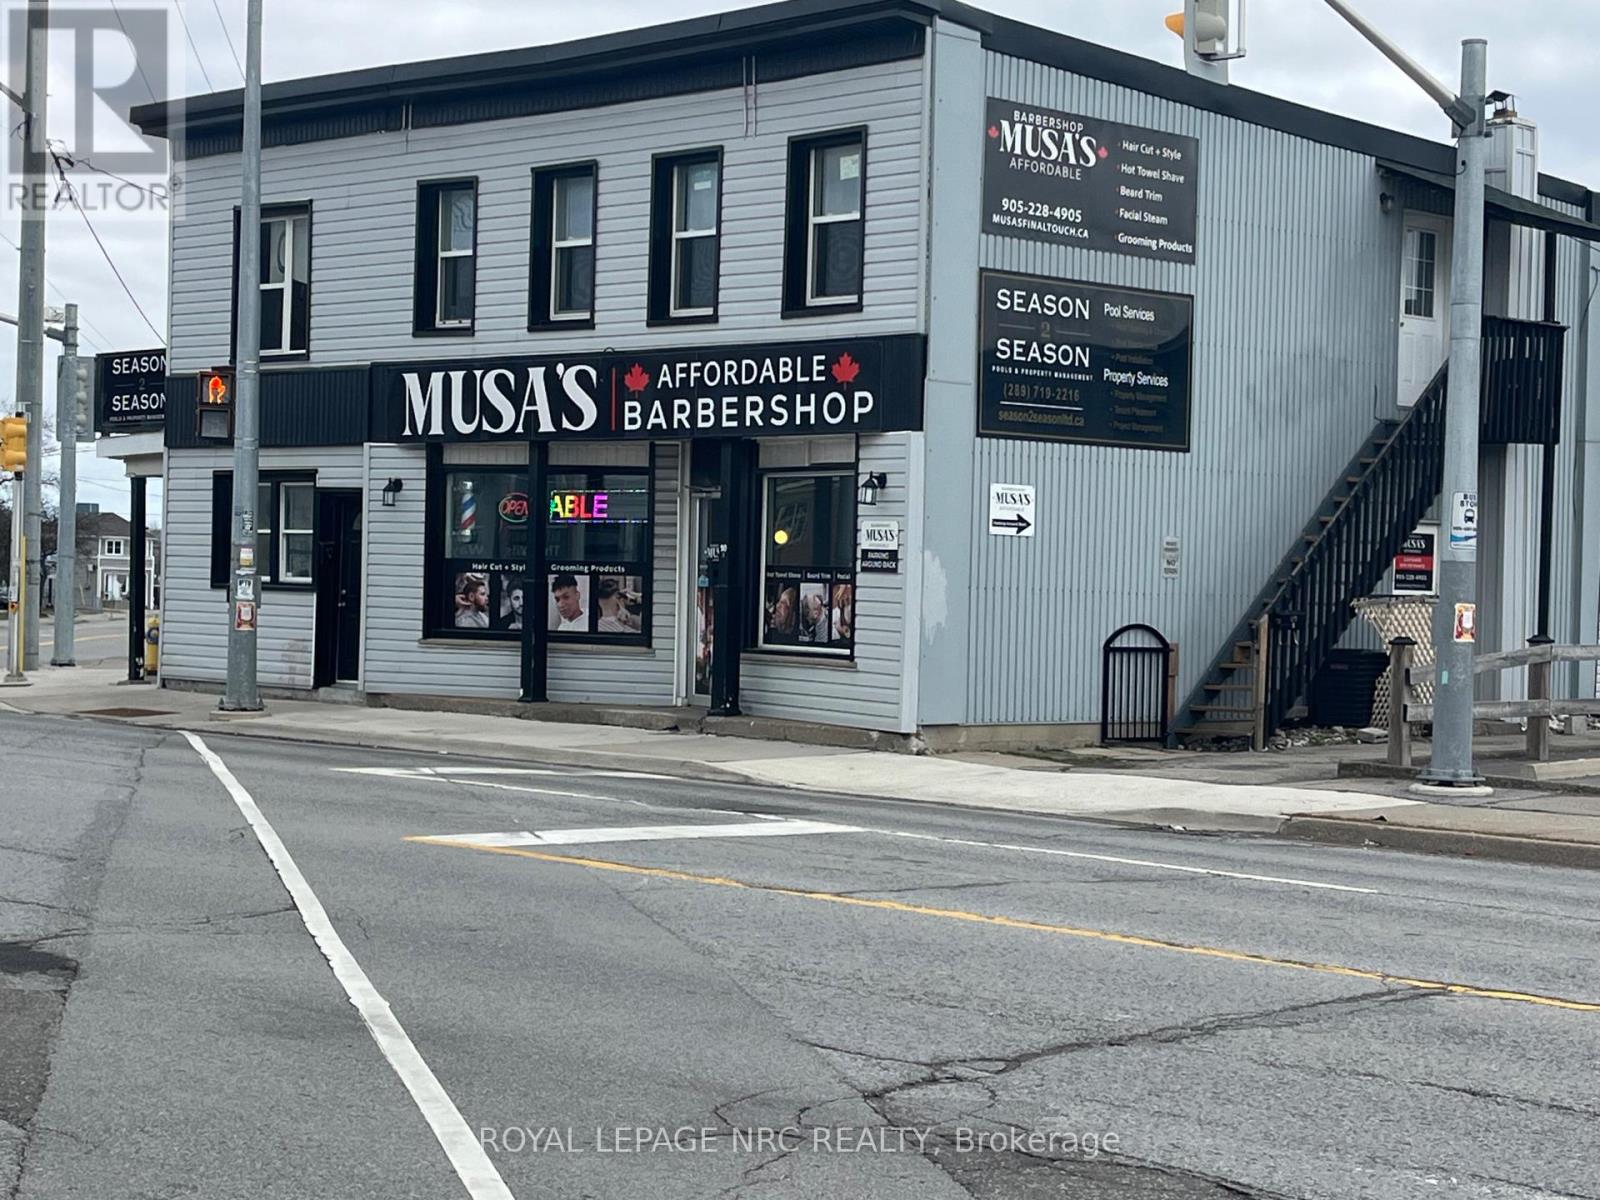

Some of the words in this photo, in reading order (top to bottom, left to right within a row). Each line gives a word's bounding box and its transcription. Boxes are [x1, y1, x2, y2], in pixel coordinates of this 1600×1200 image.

[1013, 110, 1084, 133] BARBERSHOP
[999, 119, 1097, 168] MUSA'S
[1122, 140, 1139, 152] Hair
[1140, 143, 1154, 155] Cut
[1162, 147, 1181, 160] Style
[1009, 157, 1082, 181] AFFORDABLE
[1121, 163, 1136, 175] Hot
[1137, 165, 1160, 179] Towel
[1161, 170, 1185, 184] Shave
[1120, 185, 1143, 199] Beard
[1145, 189, 1163, 202] Trim
[1001, 198, 1082, 223] 905-228-4905
[1119, 208, 1142, 221] Facial
[1143, 212, 1168, 225] Steam
[992, 213, 1089, 239] MUSASFINALTOUCH.CA
[1118, 232, 1157, 251] Grooming
[1159, 239, 1193, 253] Products
[996, 288, 1090, 320] SEASON
[1104, 302, 1121, 318] Pool
[1122, 305, 1155, 322] Services
[1040, 321, 1050, 338] 2
[996, 338, 1090, 367] SEASON
[657, 355, 826, 389] AFFORDABLE
[992, 365, 1012, 374] POOLS
[1021, 367, 1052, 377] PROPERTY
[1054, 371, 1093, 382] MANAGEMENT
[1103, 368, 1136, 387] Property
[1137, 371, 1169, 388] Services
[139, 377, 145, 390] 2
[1003, 383, 1030, 400] (289)
[401, 362, 598, 436] MUSA'S
[623, 391, 874, 431] BARBERSHOP
[550, 494, 608, 519] ABLE
[489, 563, 503, 571] Cut
[511, 563, 526, 572] Styl
[550, 563, 589, 573] Grooming
[591, 565, 625, 573] Products
